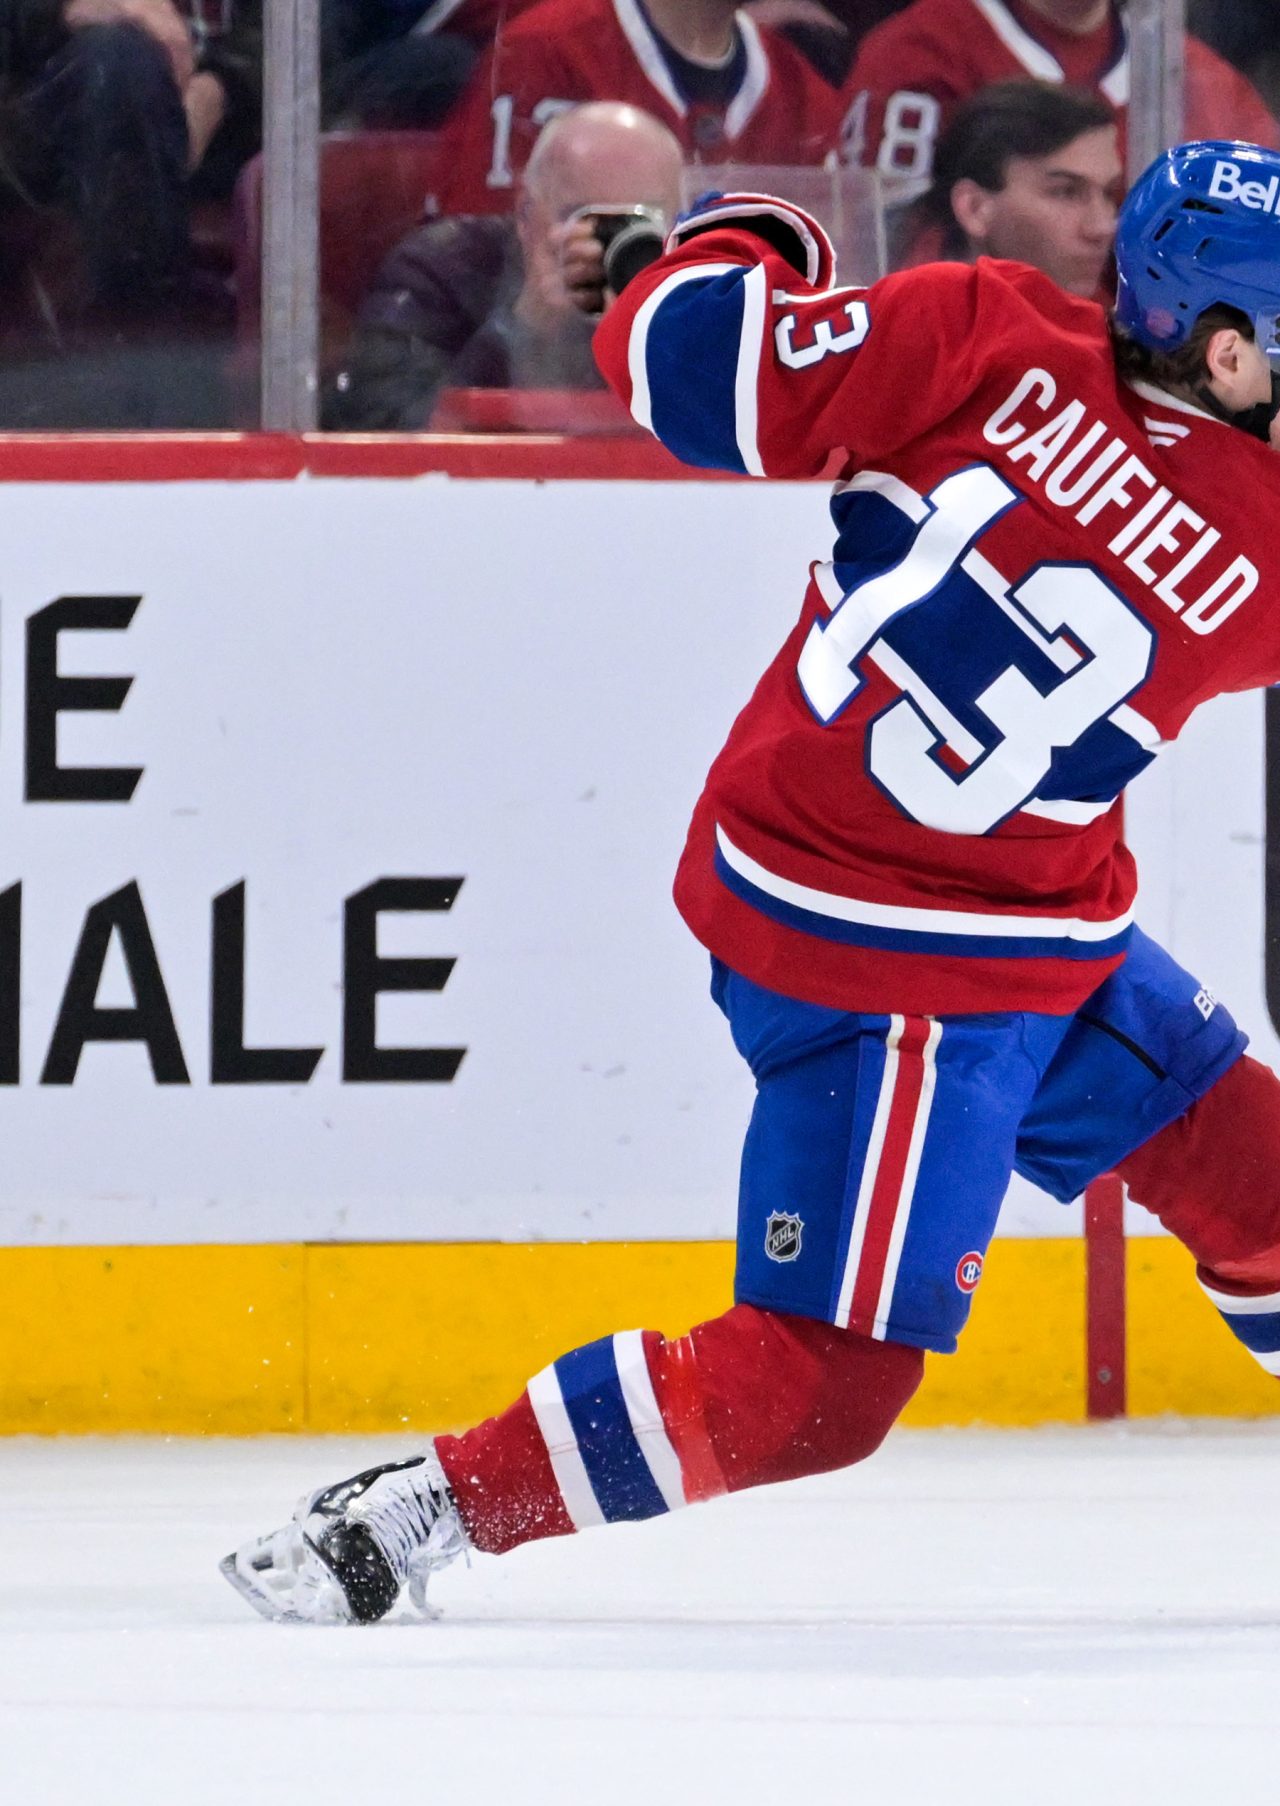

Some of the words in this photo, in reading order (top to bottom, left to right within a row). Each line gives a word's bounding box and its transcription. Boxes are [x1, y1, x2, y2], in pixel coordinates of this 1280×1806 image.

[486, 95, 578, 189] 1
[771, 286, 871, 371] 13
[982, 367, 1260, 636] CAUFIELD
[797, 461, 1158, 836] 13
[772, 1226, 795, 1251] NHL
